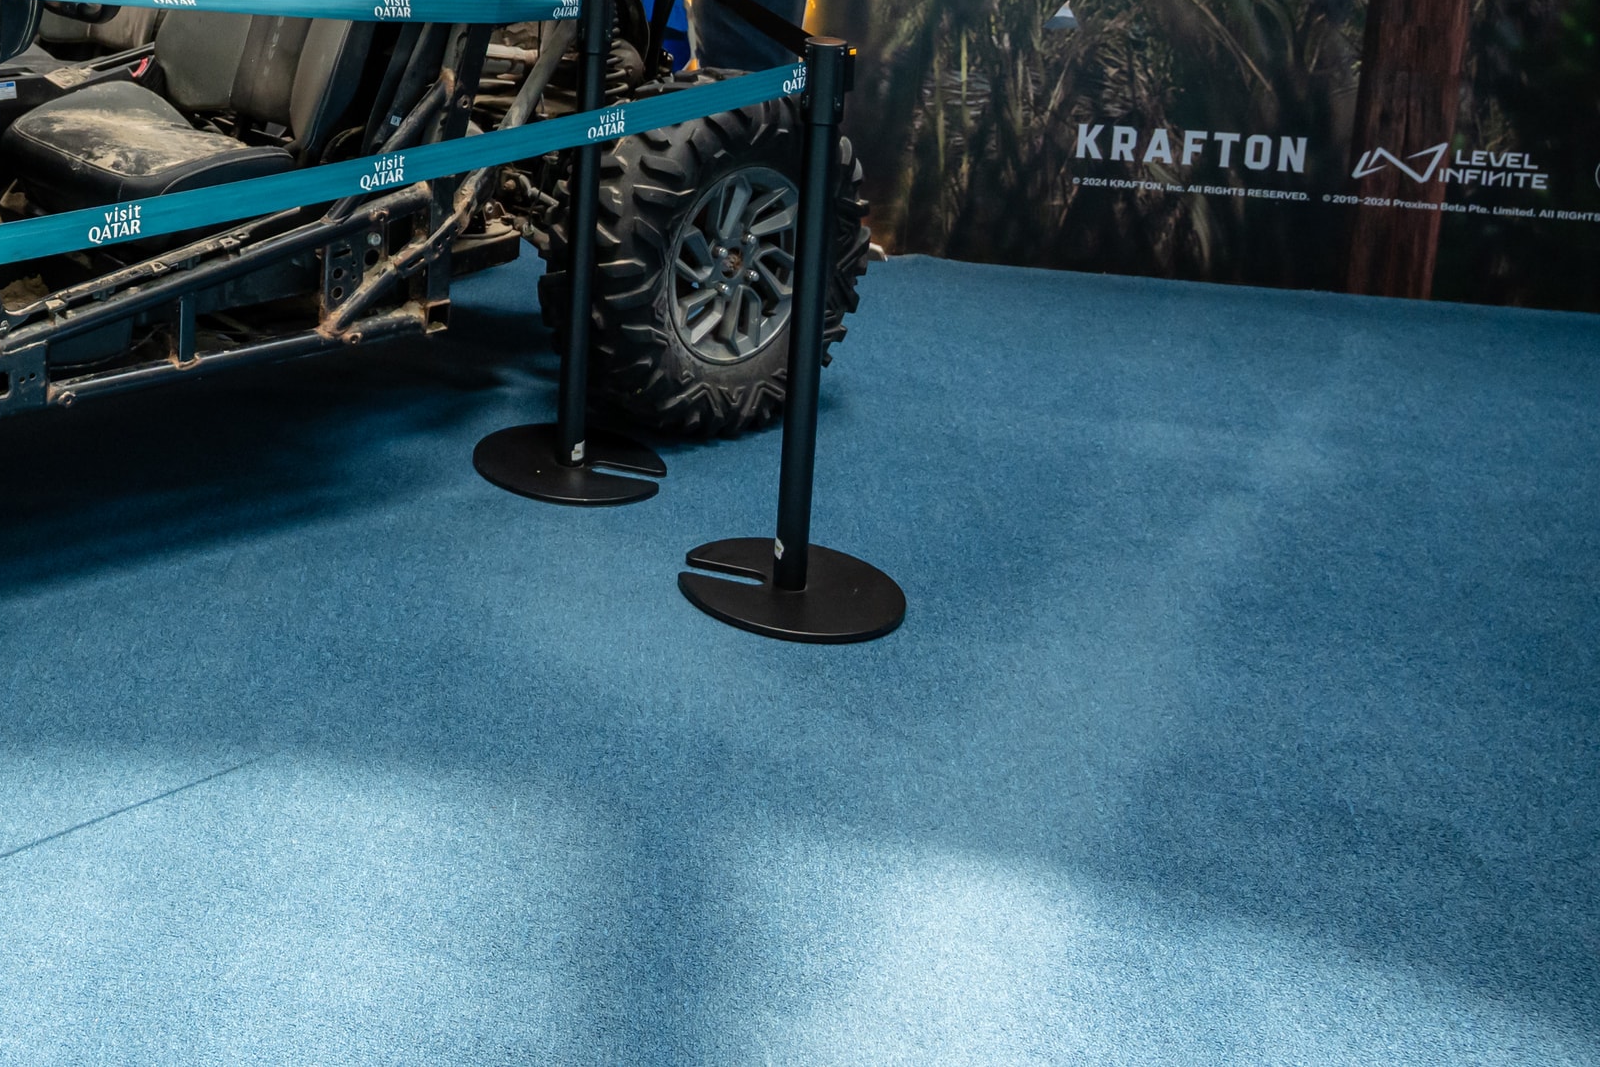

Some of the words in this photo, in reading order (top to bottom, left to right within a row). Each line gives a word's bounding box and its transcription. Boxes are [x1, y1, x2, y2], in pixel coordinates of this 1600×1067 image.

[374, 5, 411, 20] QATAR
[553, 6, 579, 19] QATAR
[793, 65, 806, 78] vis
[783, 77, 806, 94] QAT
[600, 108, 625, 125] visit
[587, 121, 625, 141] QATAR
[1075, 123, 1308, 173] KRAFTON
[374, 154, 405, 172] visit
[1455, 149, 1539, 170] LEVEL
[359, 168, 404, 190] QATAR
[1082, 177, 1107, 187] 2024
[1109, 180, 1164, 192] KRAFTON,
[1166, 183, 1185, 193] Inc.
[1187, 185, 1201, 194] All
[1204, 186, 1245, 197] RIGHTS
[1247, 189, 1310, 201] RESERVED.
[1438, 168, 1549, 190] INFINITE
[104, 204, 142, 224] visit
[1393, 199, 1438, 210] Proxima
[1440, 203, 1466, 213] Beta
[1468, 204, 1490, 215] Pte.
[1493, 206, 1536, 218] Limited.
[1539, 209, 1554, 219] All
[88, 220, 141, 244] QATAR
